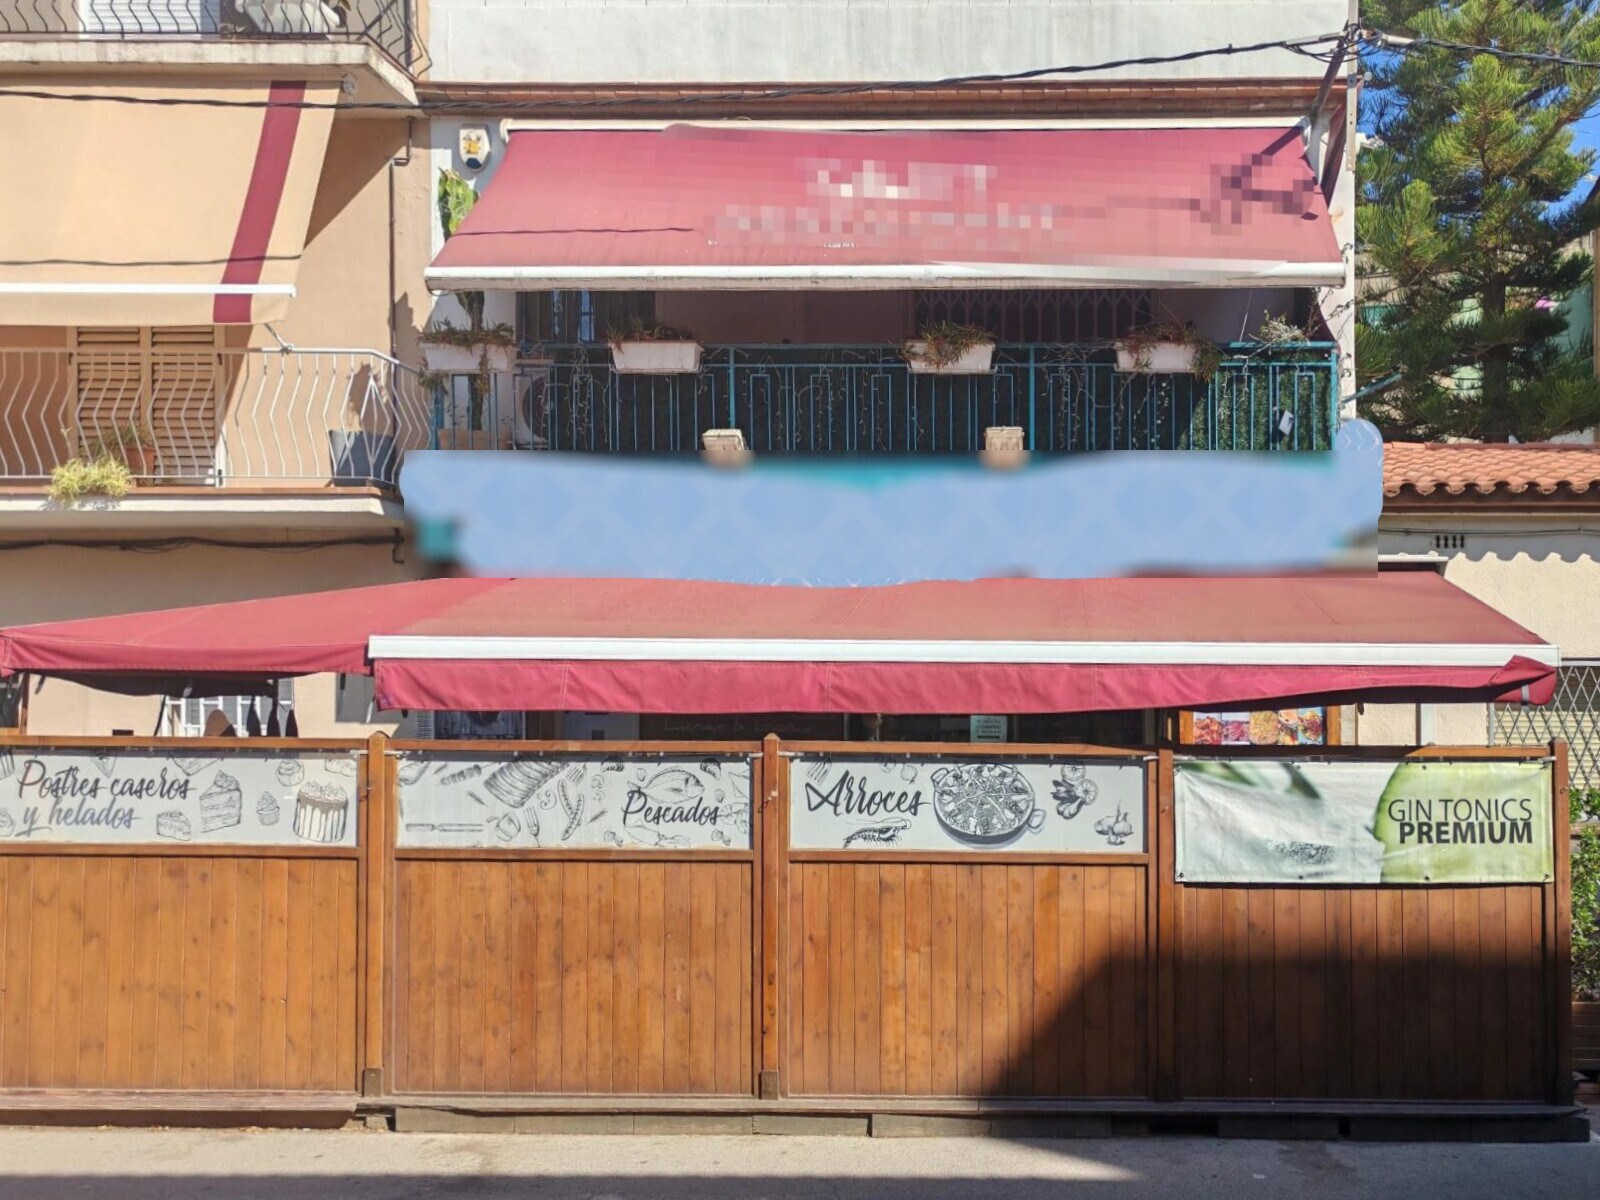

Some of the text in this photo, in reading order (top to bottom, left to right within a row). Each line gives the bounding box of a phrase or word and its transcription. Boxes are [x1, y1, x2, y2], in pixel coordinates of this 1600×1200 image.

[18, 759, 198, 799] Postres caseros
[804, 770, 932, 816] Arroces
[15, 794, 143, 836] y helados
[622, 788, 721, 826] Pescados
[1388, 798, 1533, 822] GIN TONICS
[1399, 821, 1533, 844] PREMIUM
